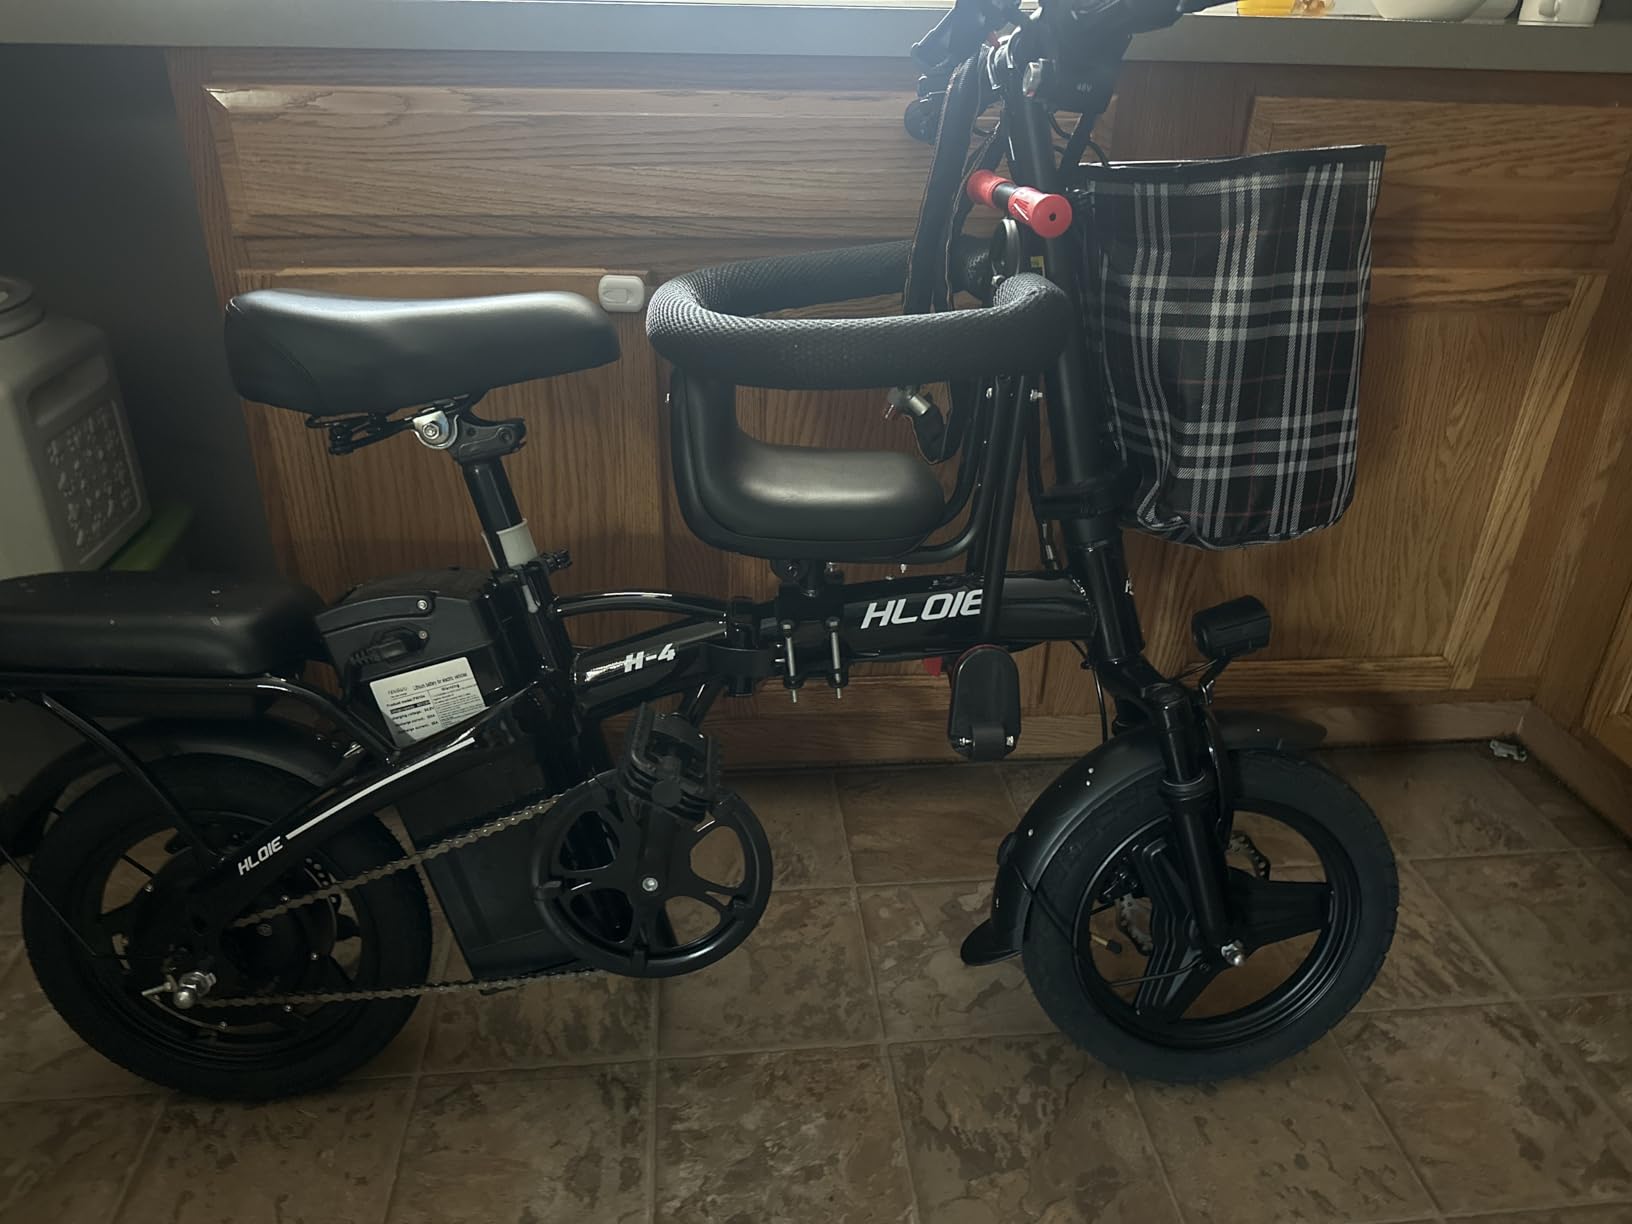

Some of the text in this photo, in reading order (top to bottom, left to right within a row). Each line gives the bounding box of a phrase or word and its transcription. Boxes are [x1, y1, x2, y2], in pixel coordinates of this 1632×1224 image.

[860, 588, 983, 629] HLOIE
[623, 643, 676, 673] H-4
[237, 835, 284, 876] HLOIE
